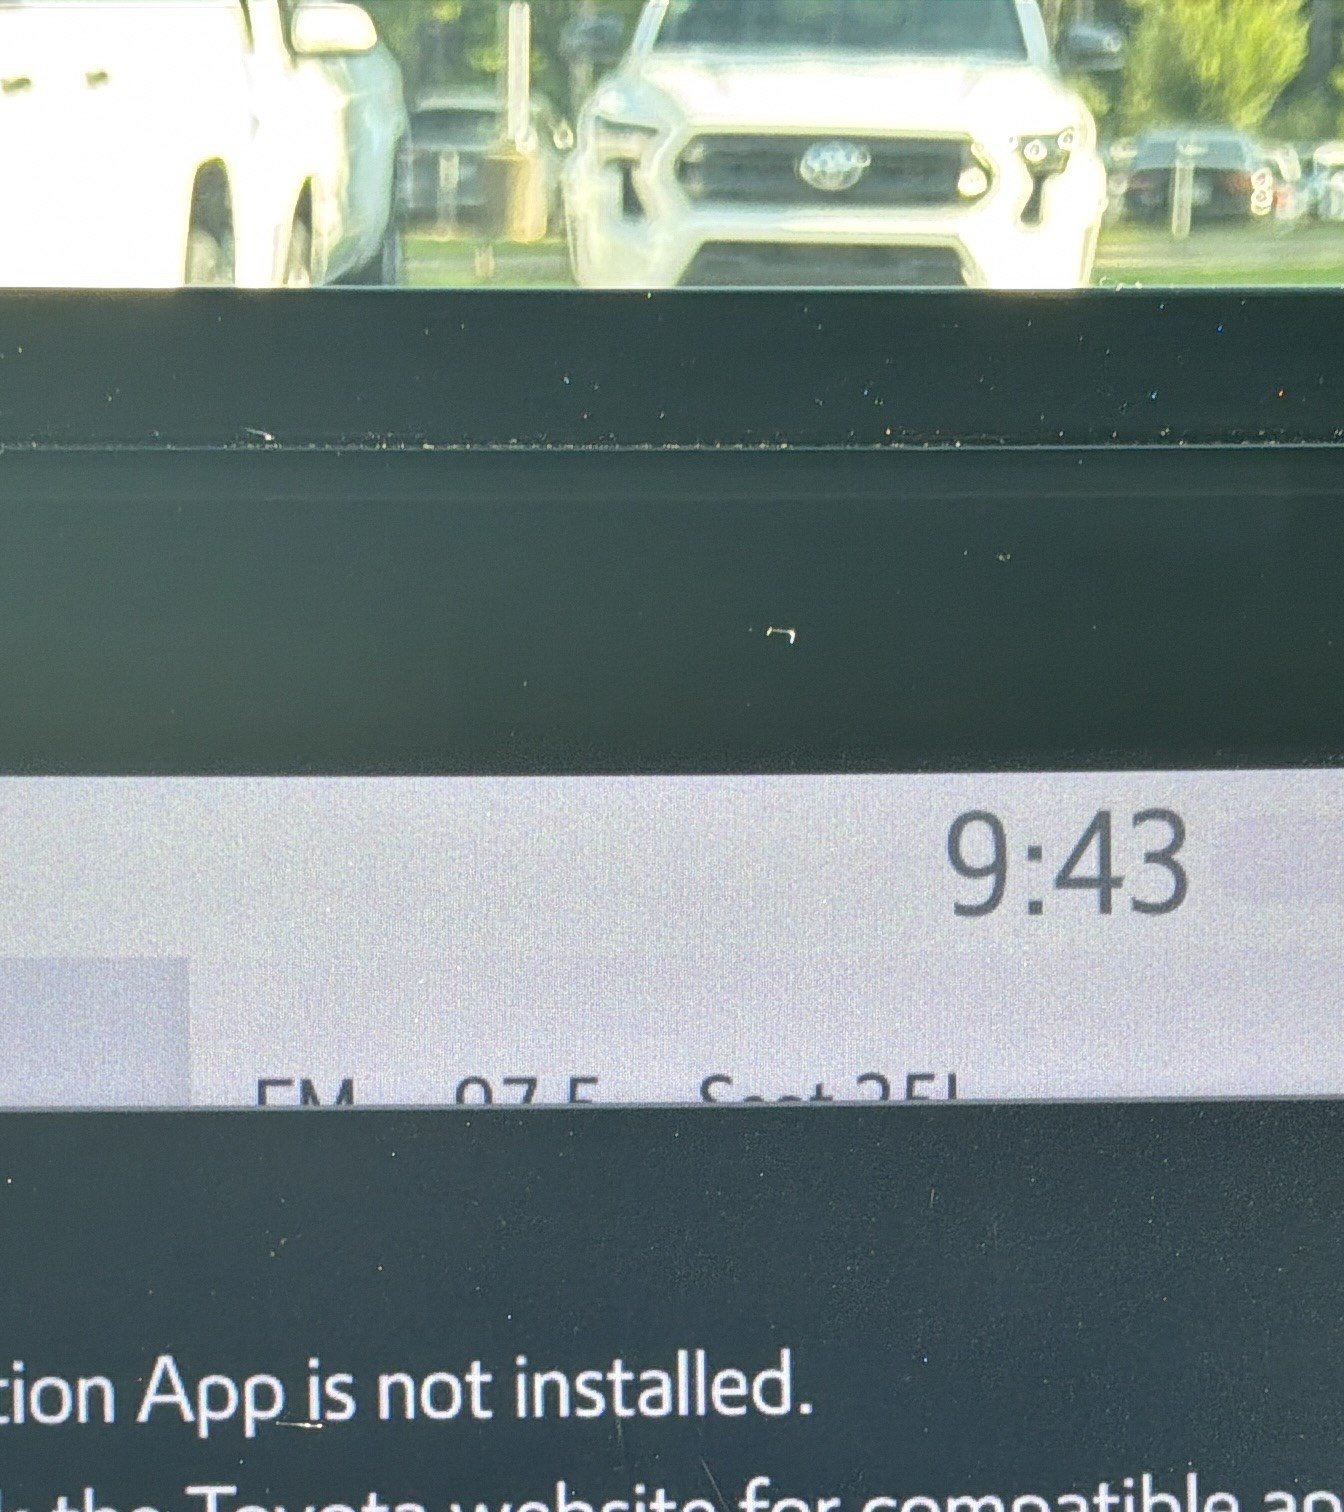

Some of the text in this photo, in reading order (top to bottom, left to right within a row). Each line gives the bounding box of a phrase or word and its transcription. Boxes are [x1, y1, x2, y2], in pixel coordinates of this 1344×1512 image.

[946, 807, 1188, 916] 9:43
[137, 1355, 284, 1438] App
[308, 1357, 356, 1420] is
[378, 1360, 493, 1420] not
[516, 1349, 812, 1418] installed.
